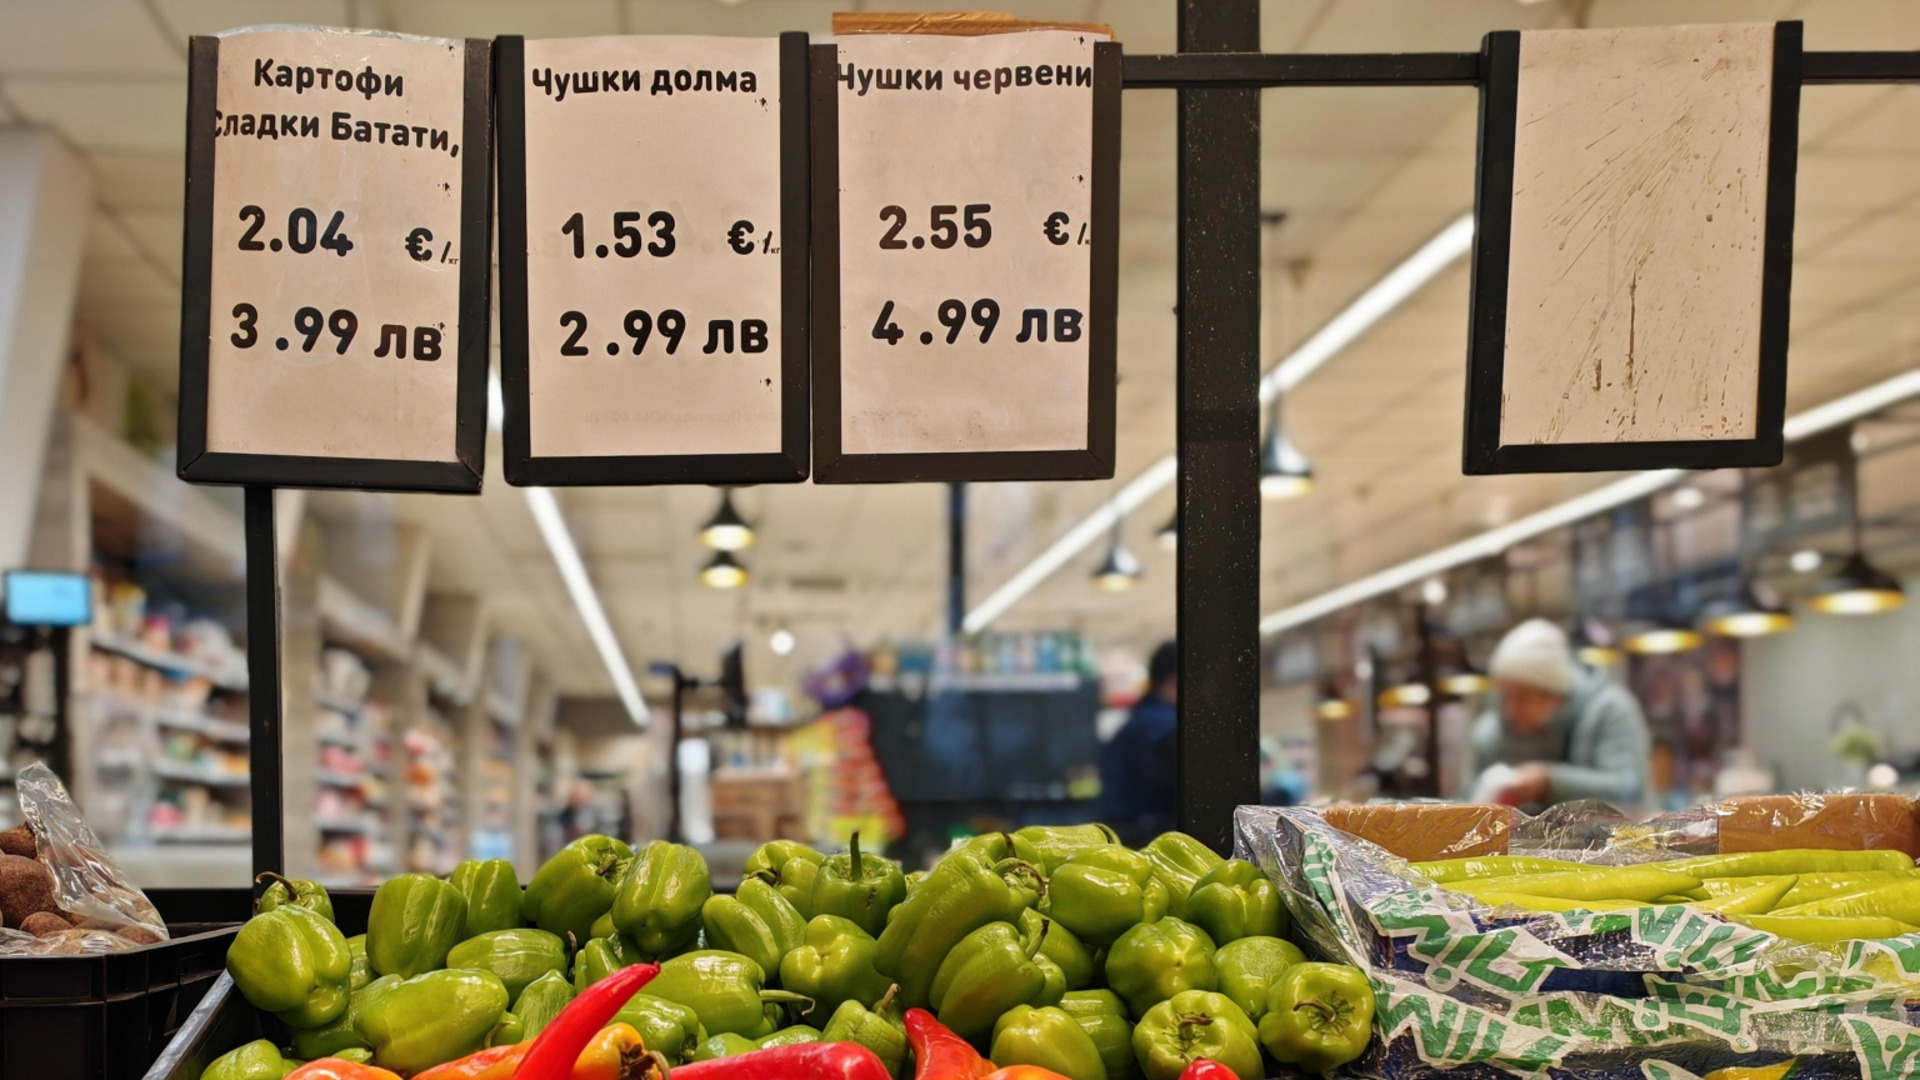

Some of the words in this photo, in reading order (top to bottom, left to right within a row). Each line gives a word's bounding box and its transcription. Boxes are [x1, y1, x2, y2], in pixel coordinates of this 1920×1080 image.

[254, 57, 404, 101] Картофи
[532, 67, 641, 102] Чушки
[650, 69, 757, 96] долма
[953, 64, 1092, 95] червени
[331, 111, 460, 158] Батати,
[237, 204, 355, 258] 2.04
[561, 210, 677, 260] 1.53
[878, 203, 992, 250] 2.55
[373, 323, 442, 362] лв
[702, 318, 769, 355] лв
[1015, 308, 1084, 344] лв
